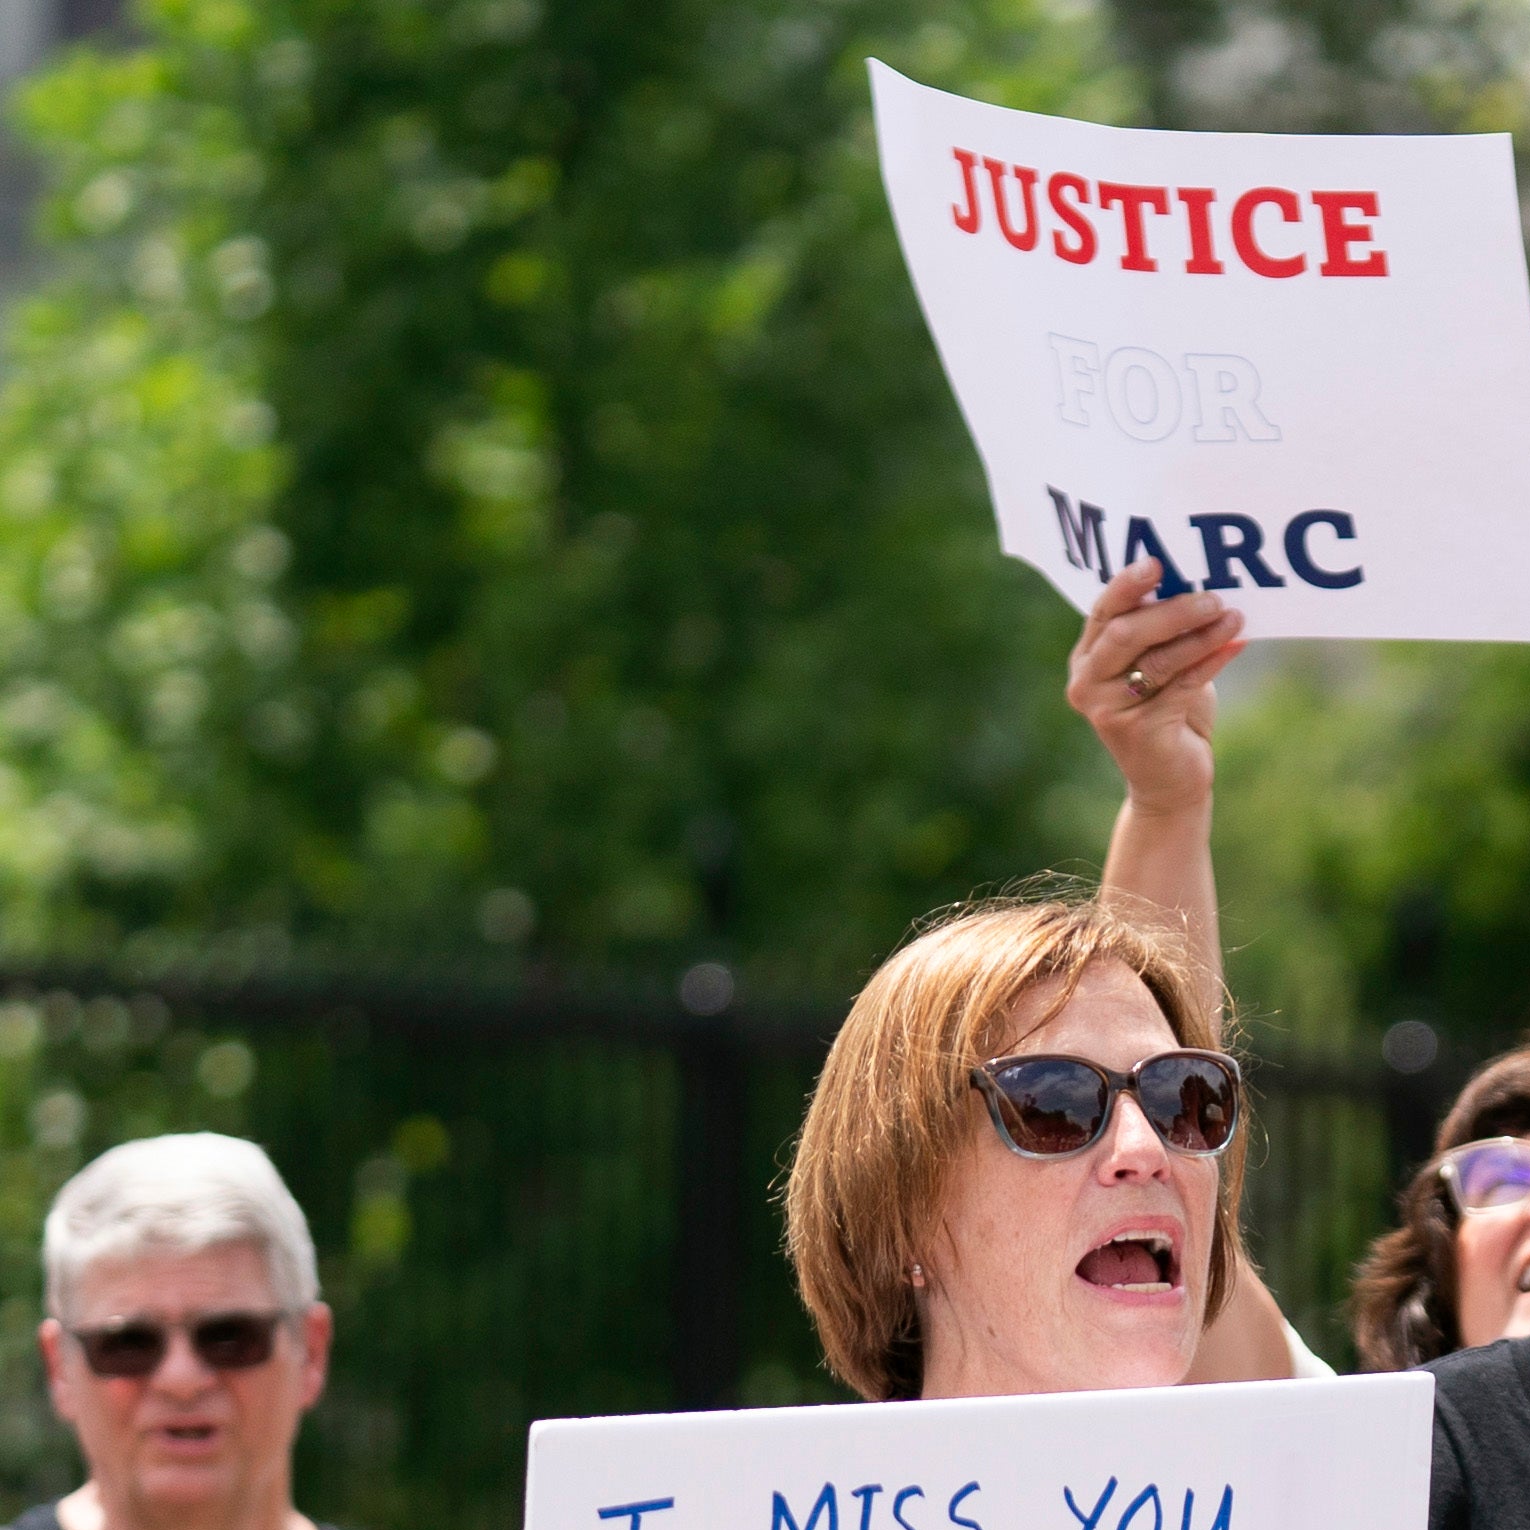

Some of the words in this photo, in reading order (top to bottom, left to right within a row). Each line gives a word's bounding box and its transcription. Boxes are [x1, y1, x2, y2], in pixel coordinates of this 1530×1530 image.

[951, 145, 1389, 279] JUSTICE
[1047, 331, 1283, 443] FOR
[1046, 482, 1365, 602] MARC
